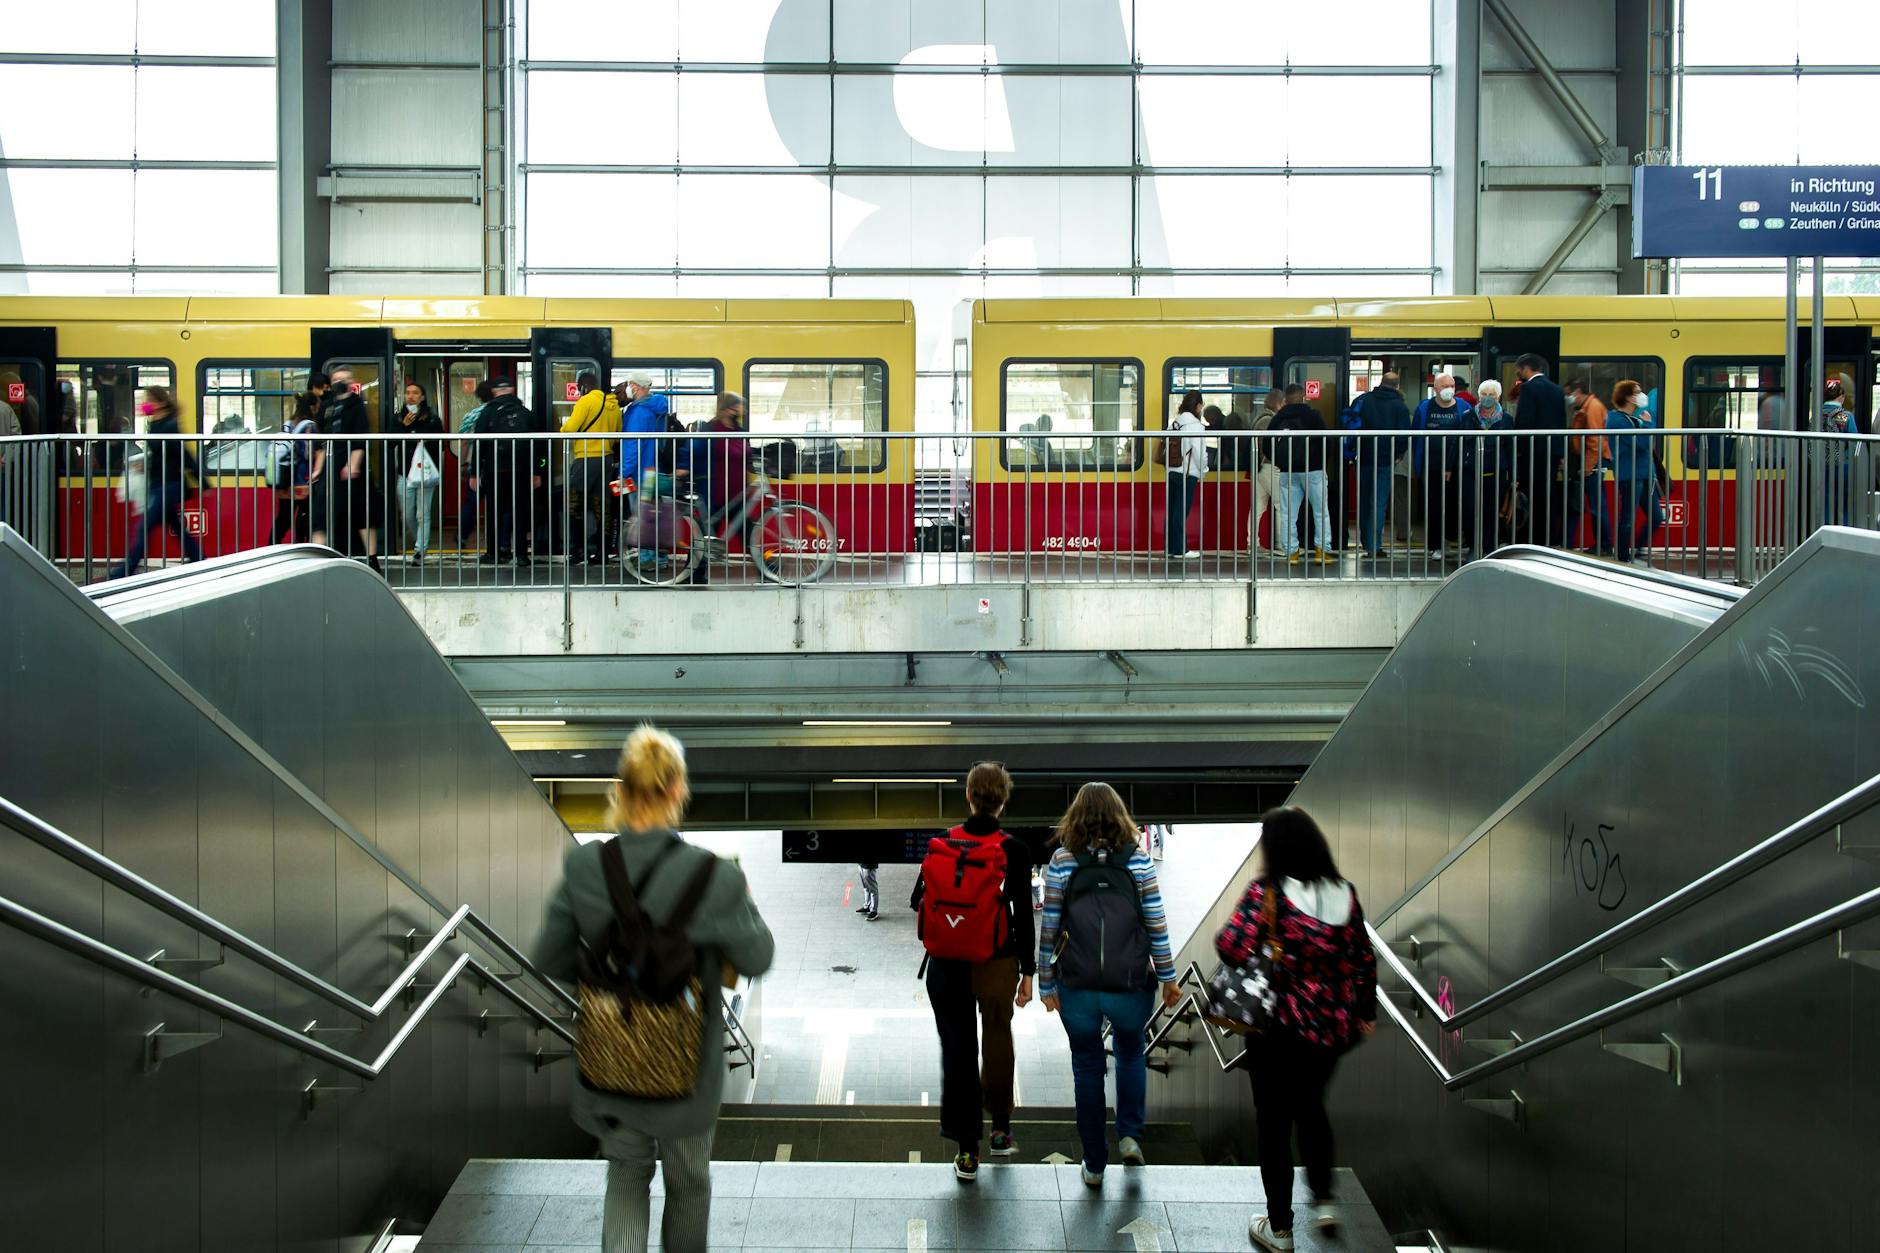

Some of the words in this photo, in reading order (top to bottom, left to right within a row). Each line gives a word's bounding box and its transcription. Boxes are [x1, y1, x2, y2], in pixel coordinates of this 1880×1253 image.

[1692, 167, 1722, 201] 11
[1790, 178, 1804, 193] in
[1808, 178, 1875, 196] Richtung
[1790, 201, 1841, 213] Neukölln
[1843, 201, 1850, 213] /
[1851, 200, 1880, 213] Südk
[1789, 217, 1837, 230] Zeuthen
[1838, 217, 1845, 230] /
[1042, 536, 1064, 548] 482
[805, 830, 820, 851] 3
